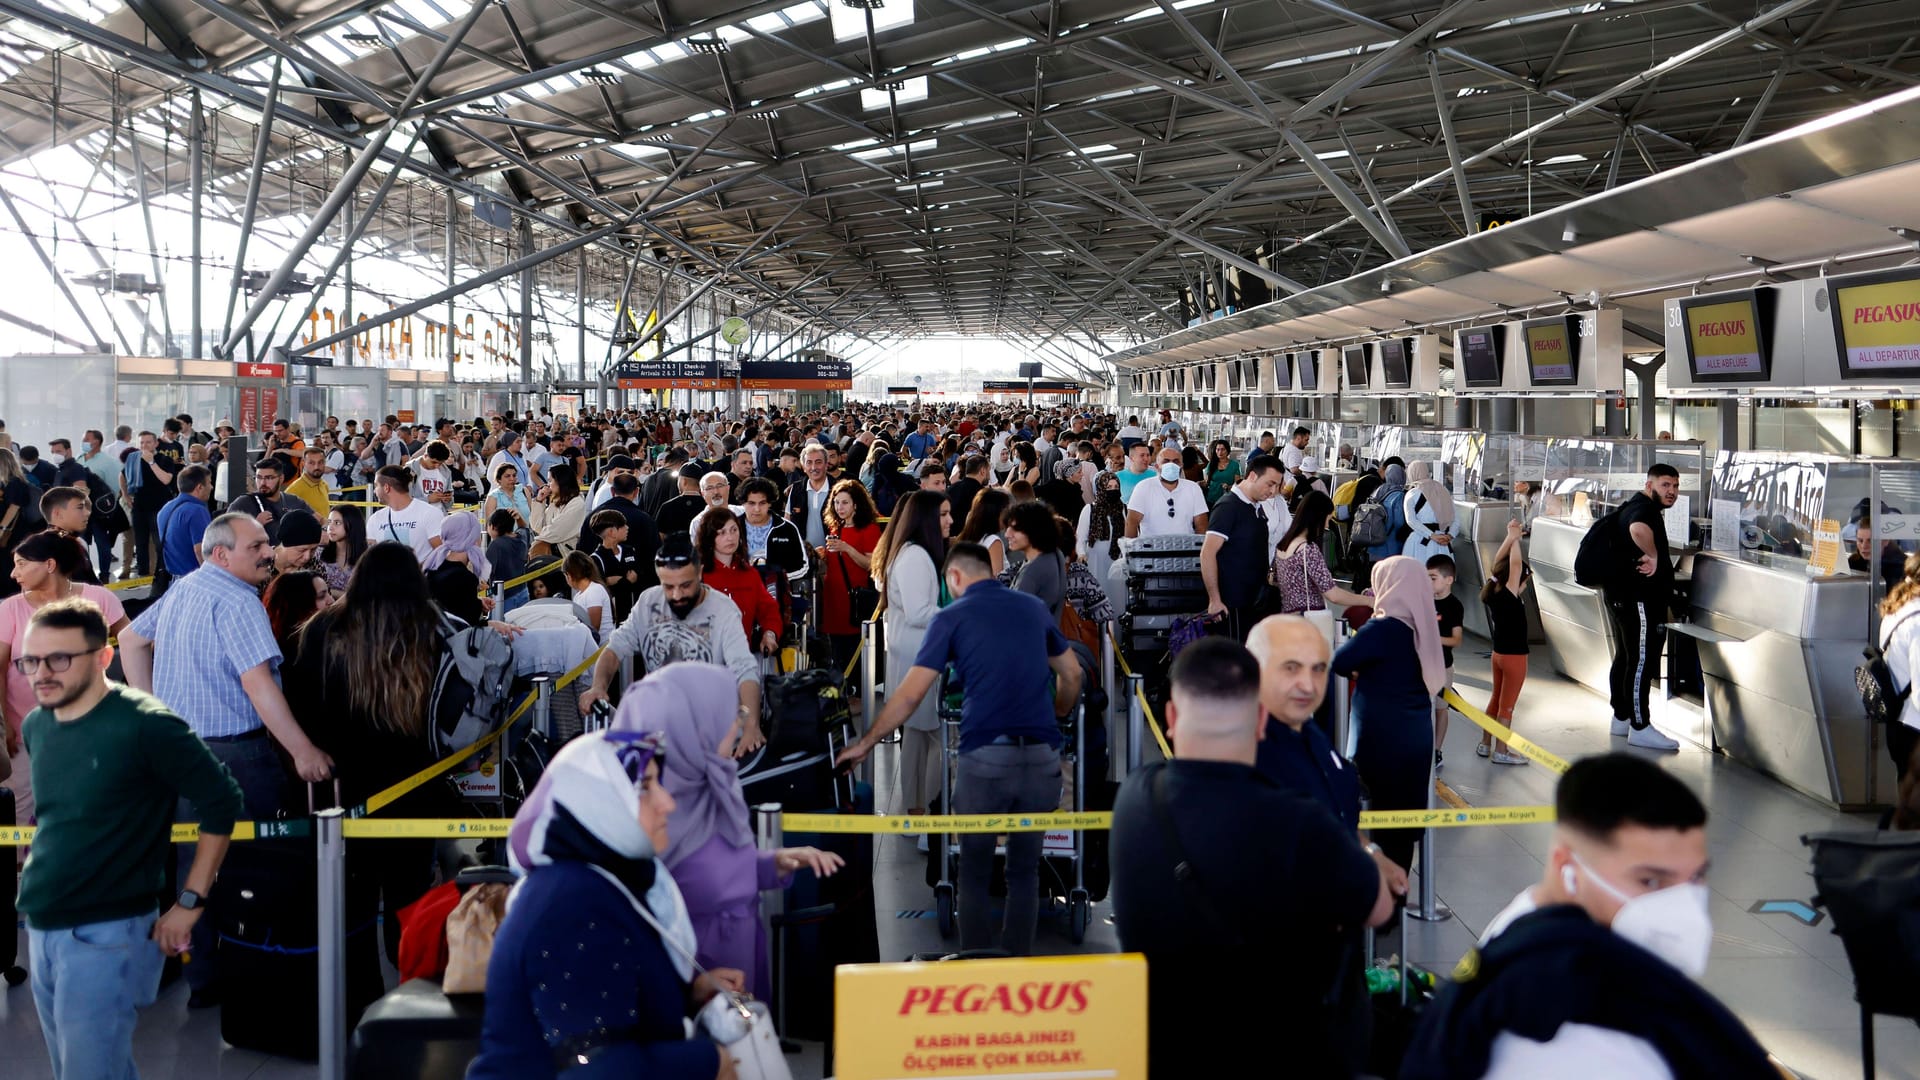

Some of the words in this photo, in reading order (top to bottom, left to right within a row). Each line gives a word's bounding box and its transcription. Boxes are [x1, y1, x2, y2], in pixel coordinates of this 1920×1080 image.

[1668, 307, 1681, 328] 30
[1578, 319, 1594, 338] 305
[1698, 319, 1746, 337] PEGASUS
[1534, 338, 1562, 351] PEGASUS
[1859, 351, 1874, 362] ALL
[1876, 349, 1920, 362] DEPARTUR
[1706, 359, 1721, 369] ALLE
[1074, 816, 1103, 826] Airport
[1391, 815, 1419, 825] Airport
[1470, 812, 1486, 821] Köln
[1509, 811, 1536, 821] Airport
[470, 823, 487, 832] Köln
[489, 823, 508, 832] Bonn
[953, 820, 982, 829] Airport
[1043, 832, 1069, 841] rendon
[898, 979, 1093, 1017] PEGASUS
[975, 1030, 1076, 1047] BAGAJINIZI
[902, 1051, 977, 1071] ÖLÇMEK
[982, 1051, 1019, 1070] ÇOK
[1024, 1048, 1086, 1065] KOLAY.
